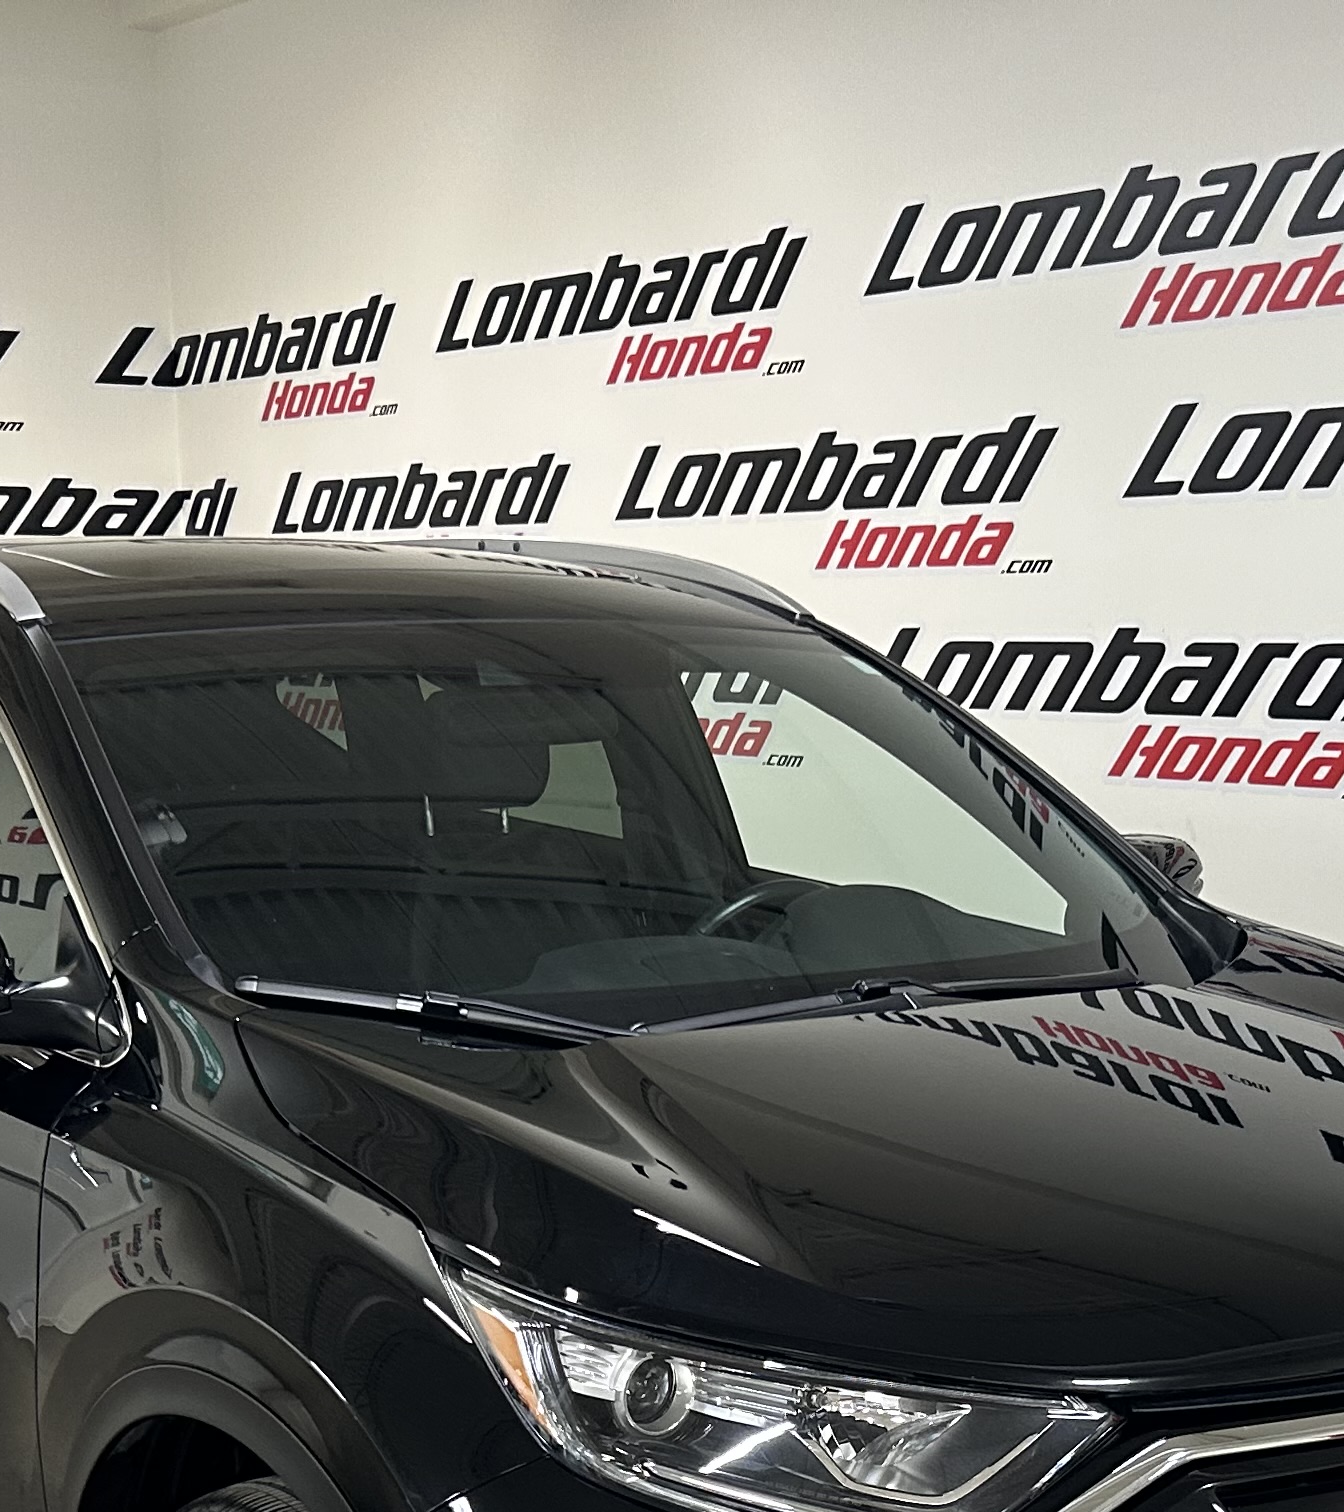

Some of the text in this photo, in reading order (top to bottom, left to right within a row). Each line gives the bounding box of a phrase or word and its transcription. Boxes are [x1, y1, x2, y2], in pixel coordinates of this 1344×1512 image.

[436, 226, 807, 352] Lombardi
[95, 294, 396, 387] Lombardi
[608, 323, 805, 384] Honda .com
[263, 373, 398, 419] Honda .com
[272, 453, 571, 535] Lombardi
[615, 415, 1059, 520] Lombardi
[817, 514, 1052, 573] Honda .com
